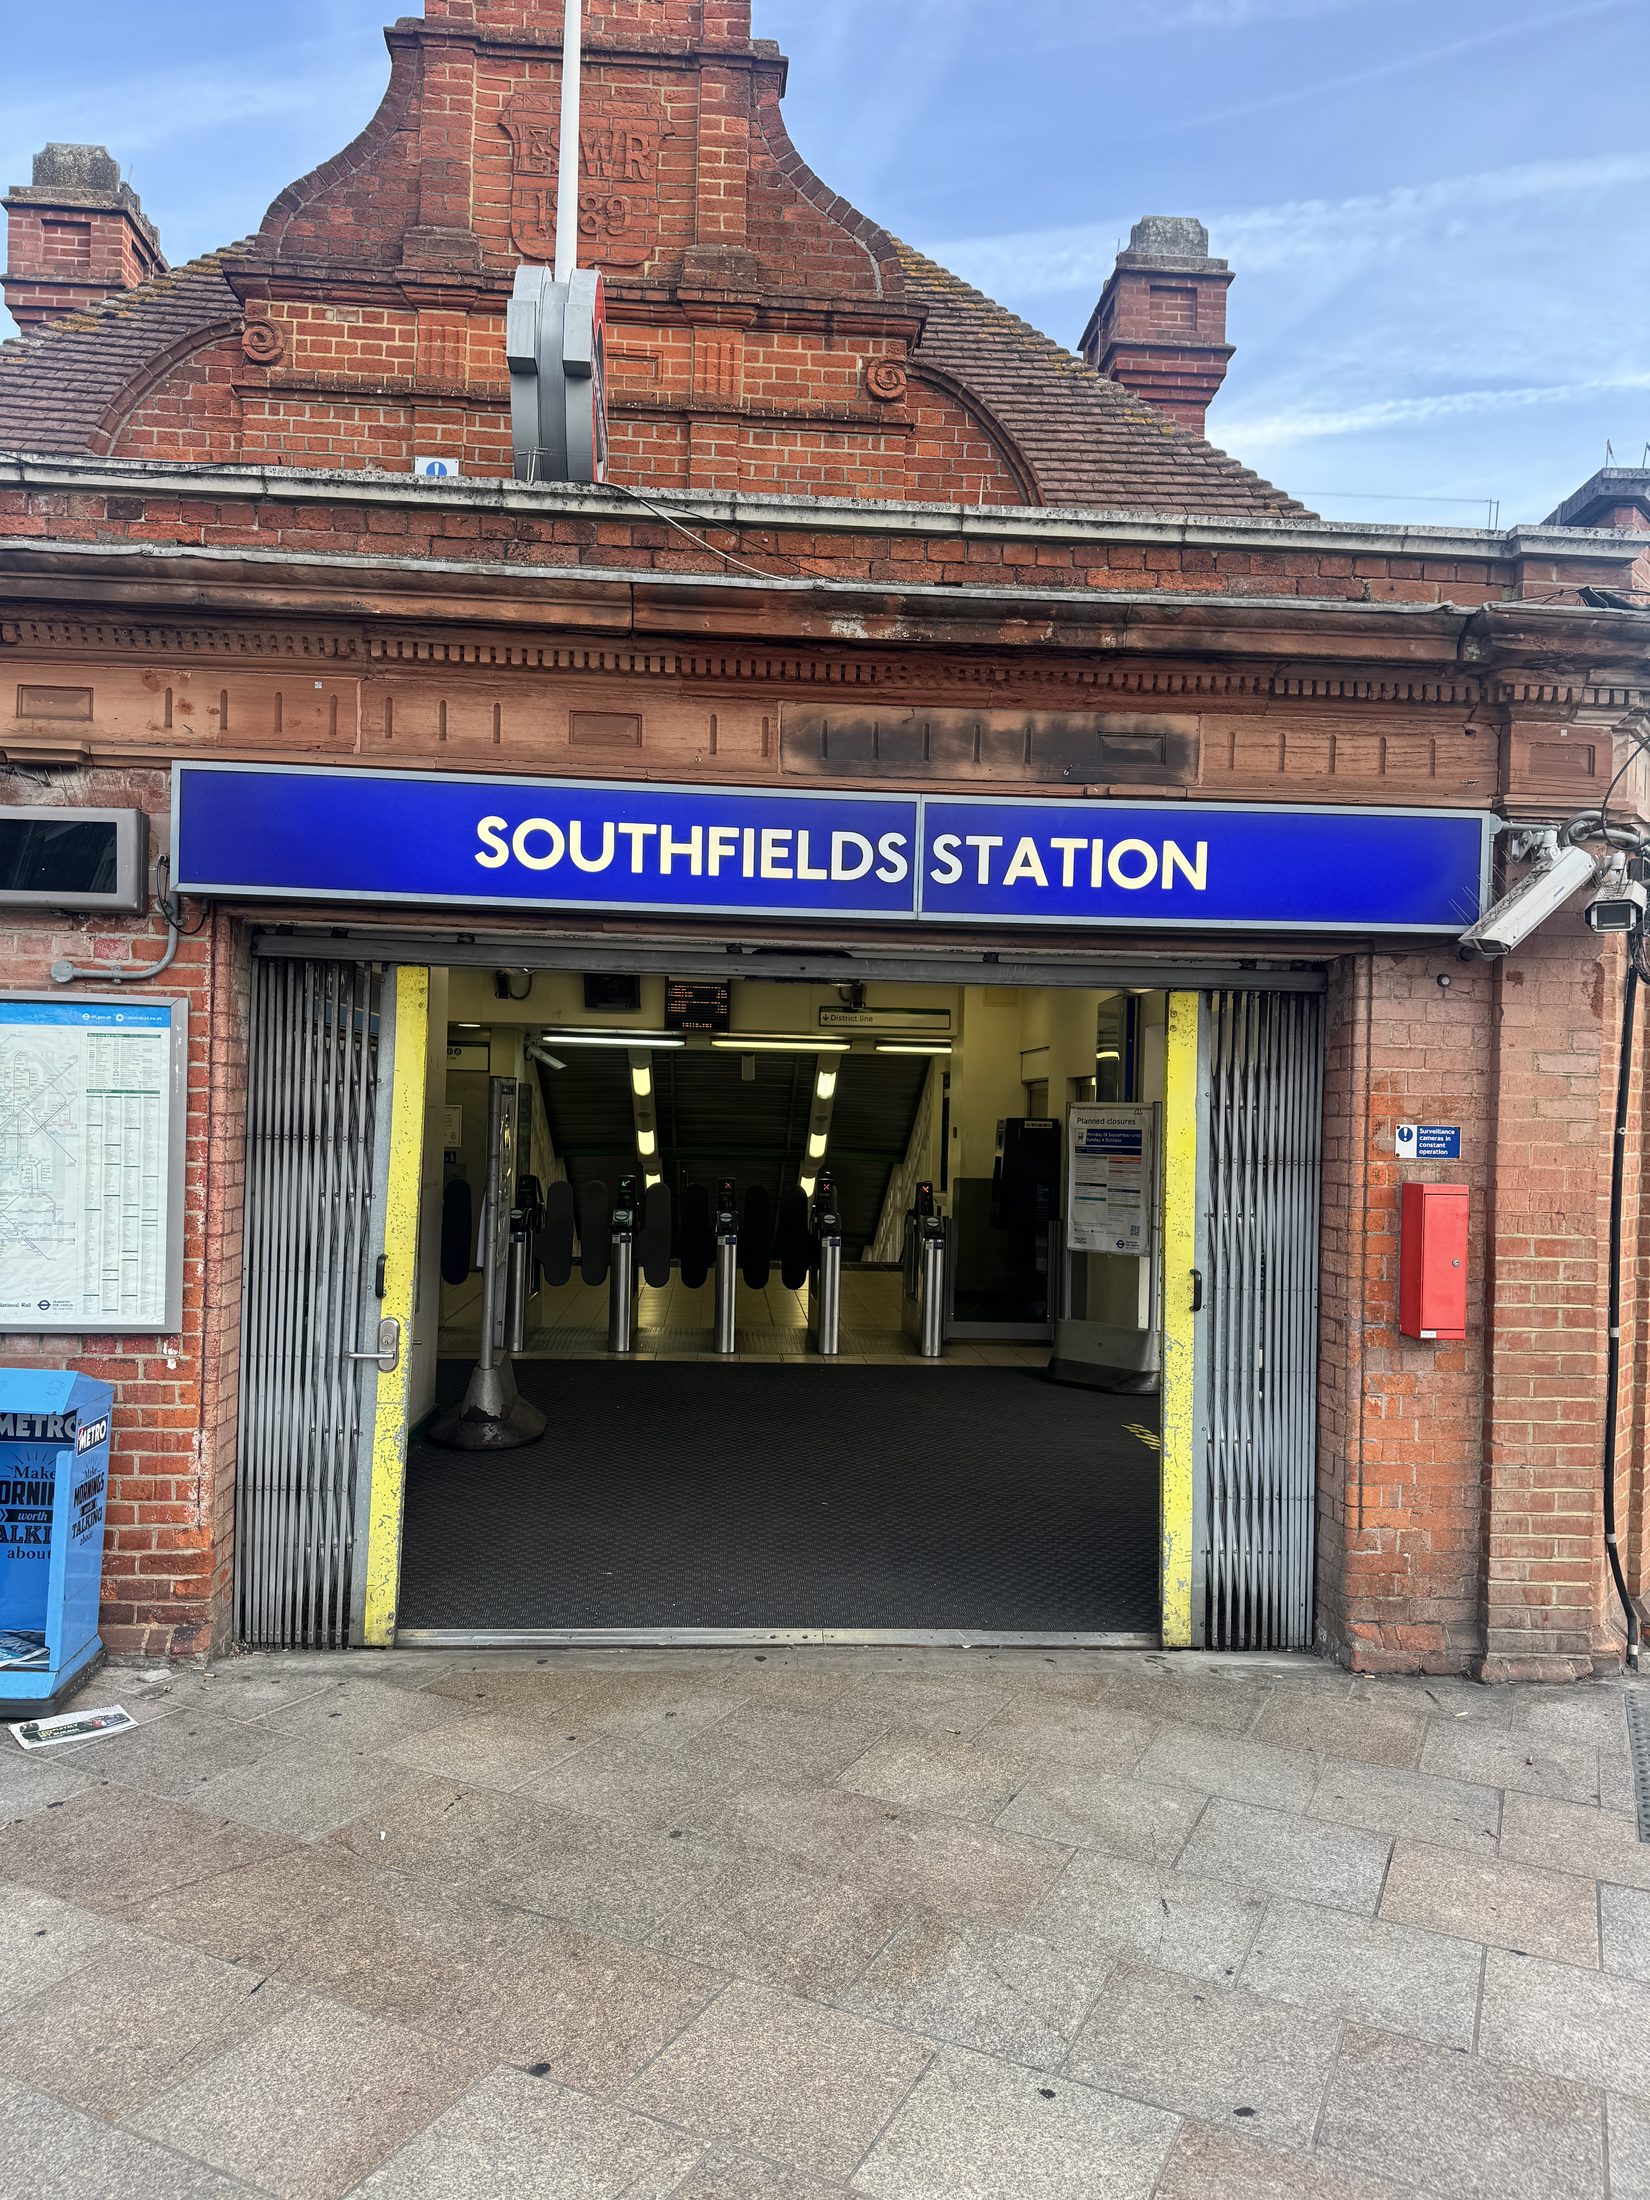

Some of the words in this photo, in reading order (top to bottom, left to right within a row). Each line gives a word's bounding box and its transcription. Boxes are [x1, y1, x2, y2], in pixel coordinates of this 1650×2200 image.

[474, 815, 908, 884] SOUTHFIELDS
[930, 833, 1208, 890] STATION
[830, 1014, 858, 1022] District
[1077, 1117, 1105, 1125] Planned
[79, 1420, 107, 1452] METRO
[13, 1466, 55, 1479] Make
[74, 1472, 105, 1508] MORNINGS
[17, 1511, 48, 1521] worth
[72, 1506, 103, 1540] TALKING
[7, 1546, 51, 1560] about
